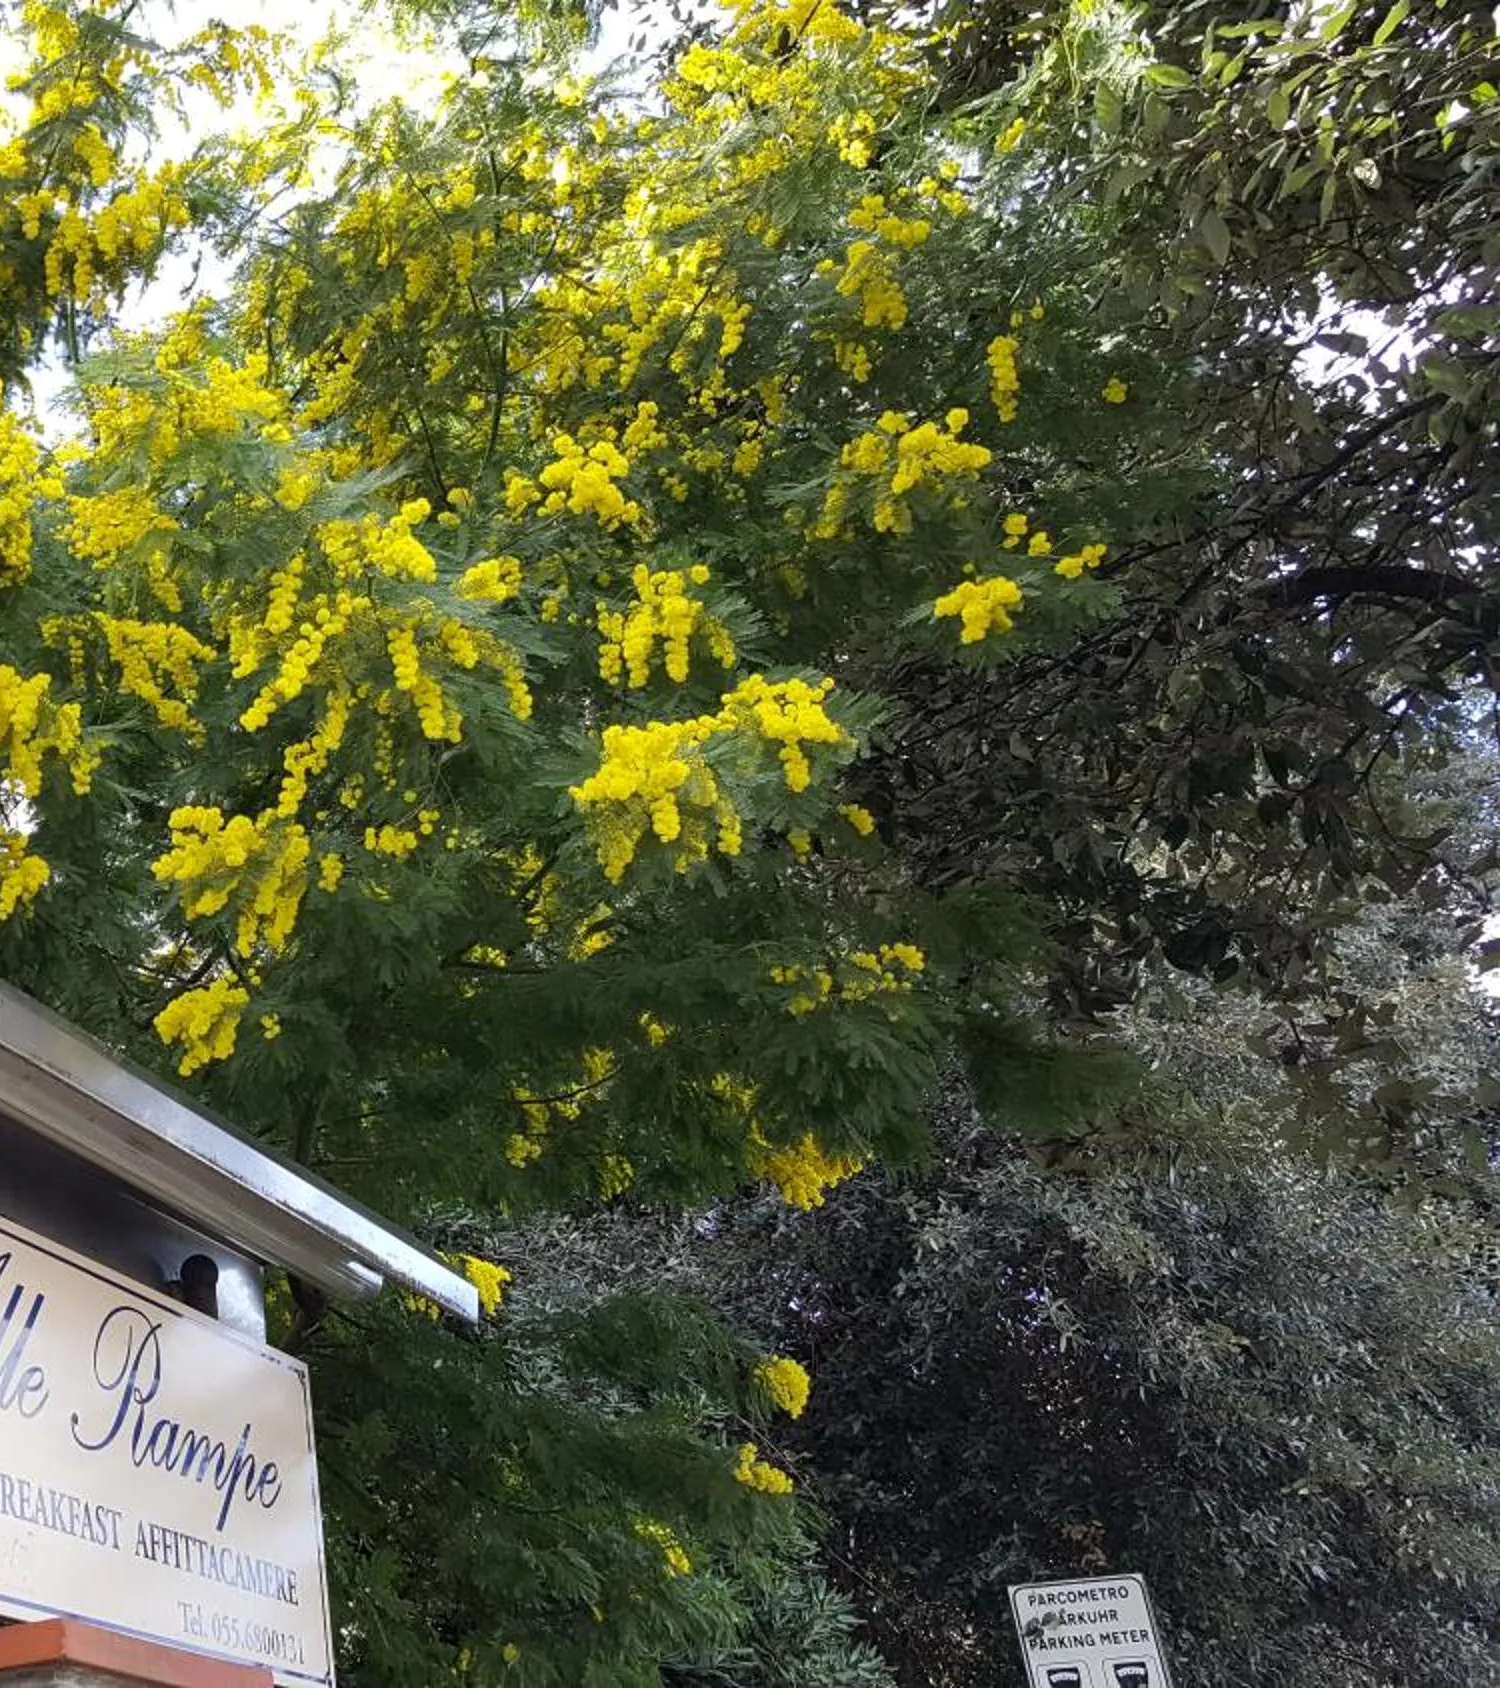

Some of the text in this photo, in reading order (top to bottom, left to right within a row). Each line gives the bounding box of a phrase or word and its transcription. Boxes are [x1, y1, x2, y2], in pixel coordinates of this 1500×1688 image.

[71, 1305, 283, 1530] Rampe
[135, 1519, 299, 1606] AFFITTACAMERE
[1028, 1586, 1129, 1606] PARCOMETRO
[177, 1601, 208, 1638] Tel.
[1054, 1608, 1119, 1627] ARKUHR
[1028, 1629, 1150, 1651] PARKING METER
